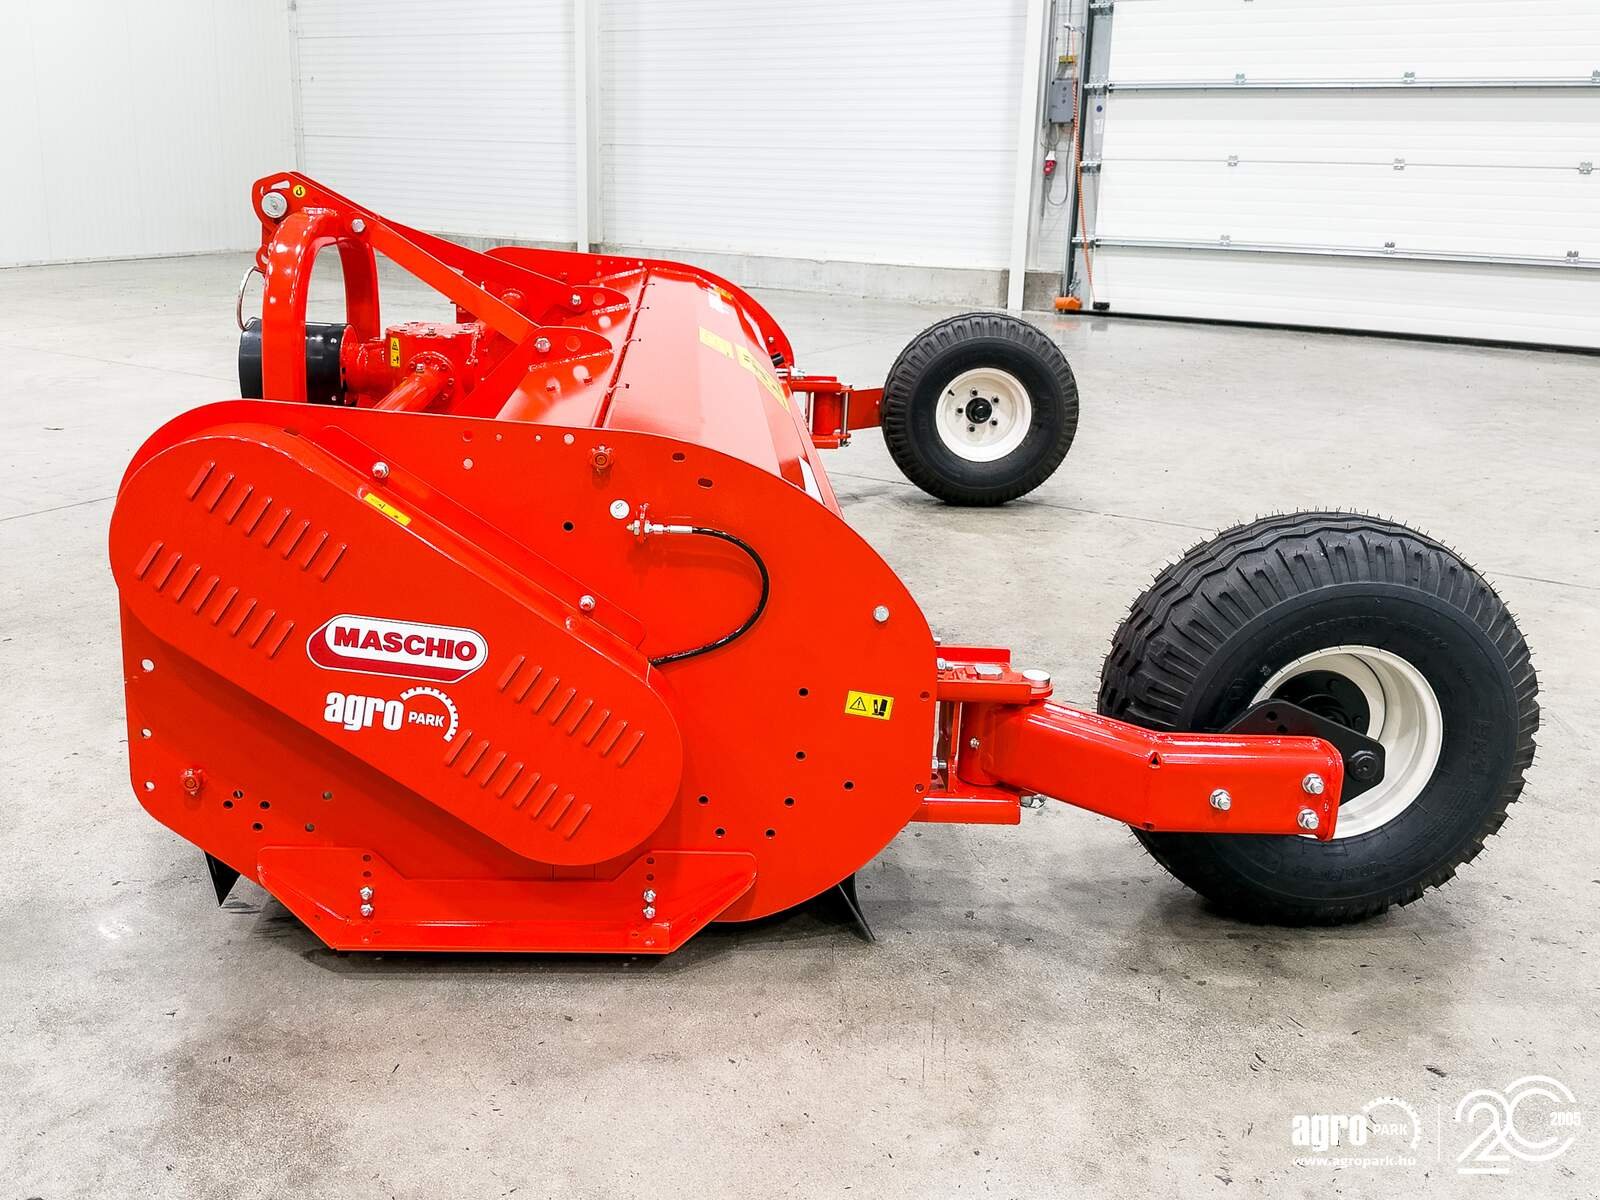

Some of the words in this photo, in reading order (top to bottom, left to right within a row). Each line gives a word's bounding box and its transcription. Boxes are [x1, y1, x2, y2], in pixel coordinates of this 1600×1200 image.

[334, 627, 477, 661] MASCHIO
[324, 692, 404, 731] agro
[408, 711, 444, 727] PARK
